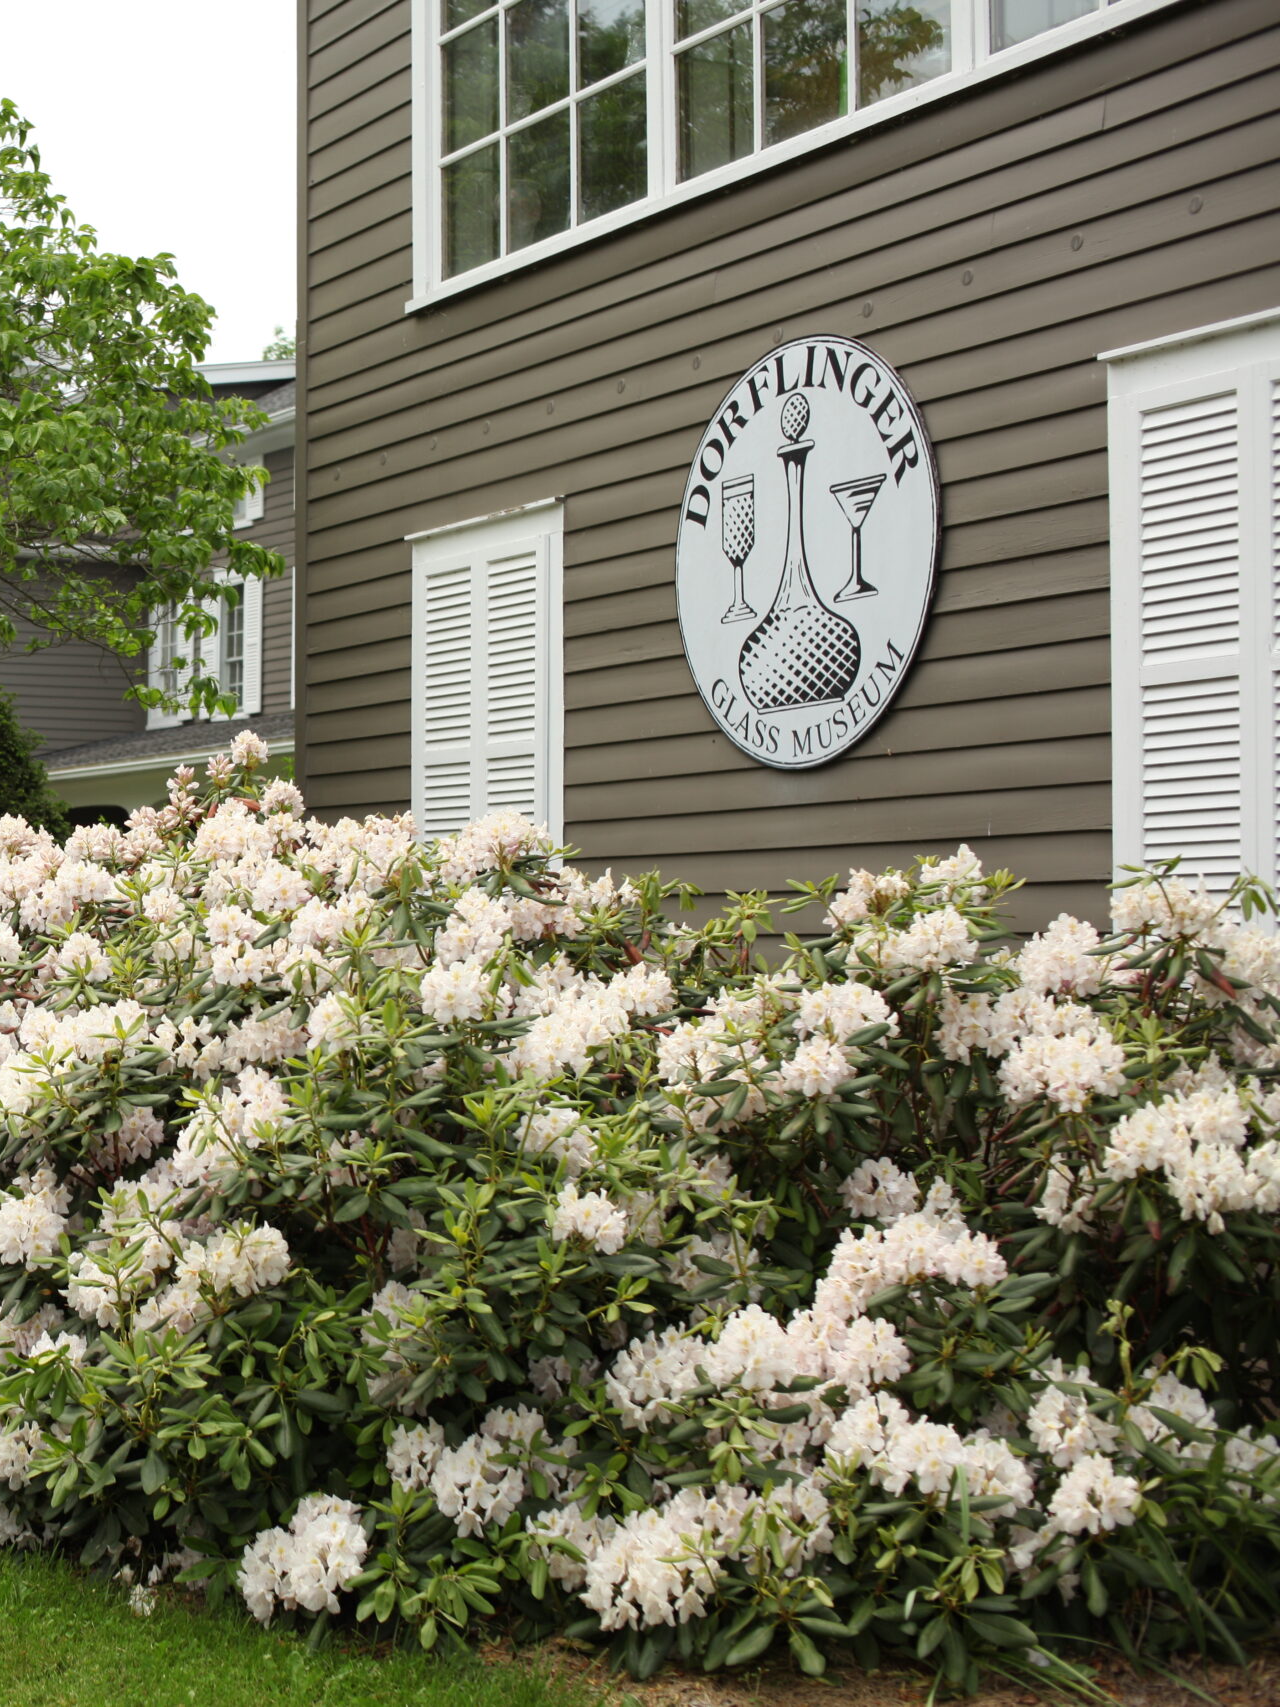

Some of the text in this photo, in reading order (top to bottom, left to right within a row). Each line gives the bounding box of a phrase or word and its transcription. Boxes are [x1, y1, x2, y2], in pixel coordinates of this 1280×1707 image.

[685, 345, 921, 530] DORFLINGER
[711, 638, 905, 758] GLASS MUSEUM
